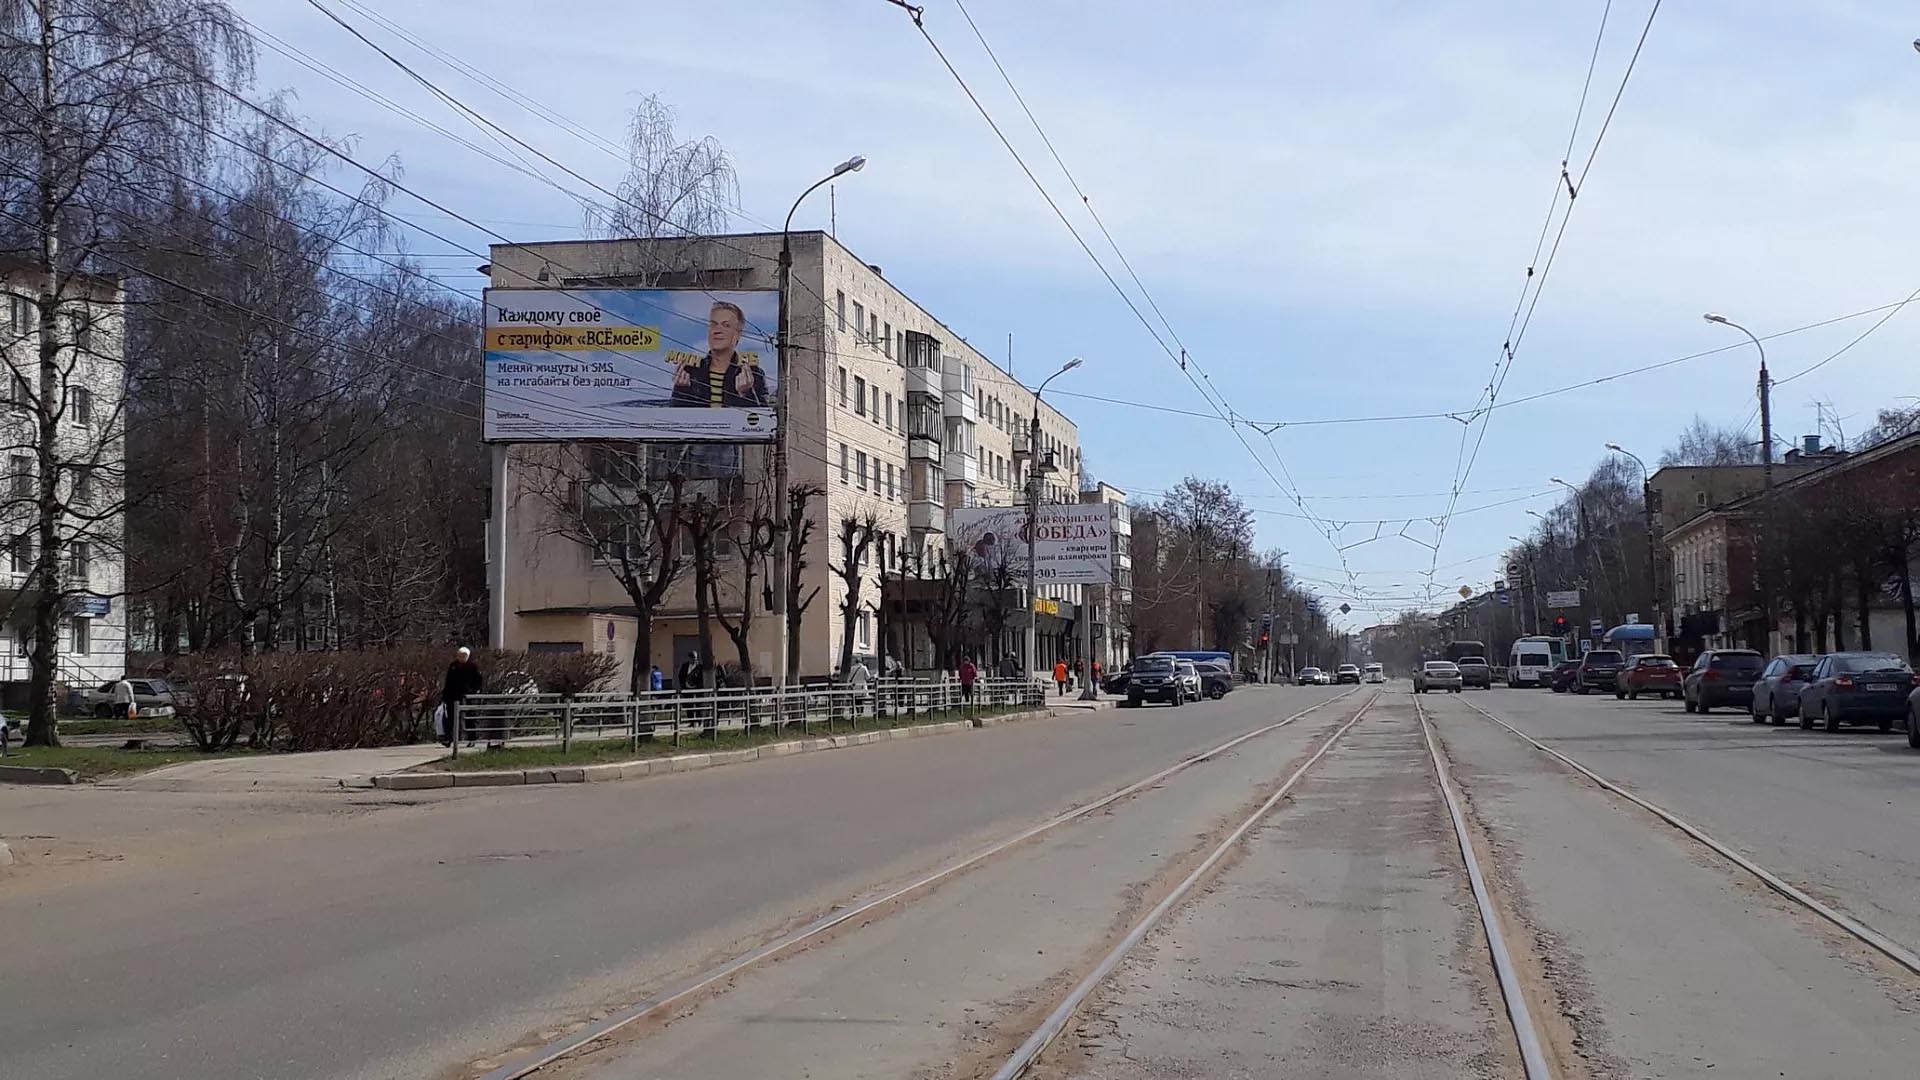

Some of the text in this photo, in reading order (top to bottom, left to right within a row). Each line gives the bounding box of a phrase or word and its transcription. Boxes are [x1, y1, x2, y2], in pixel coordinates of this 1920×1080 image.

[498, 307, 601, 326] Каждому своё
[497, 327, 653, 349] с тарифом «ВСЁмоё!»
[497, 362, 614, 376] Меняй минуты и SMS
[497, 375, 632, 389] на гигабайты без доплат
[1014, 513, 1106, 525] ЖИОЙ КОМПЛЕКС
